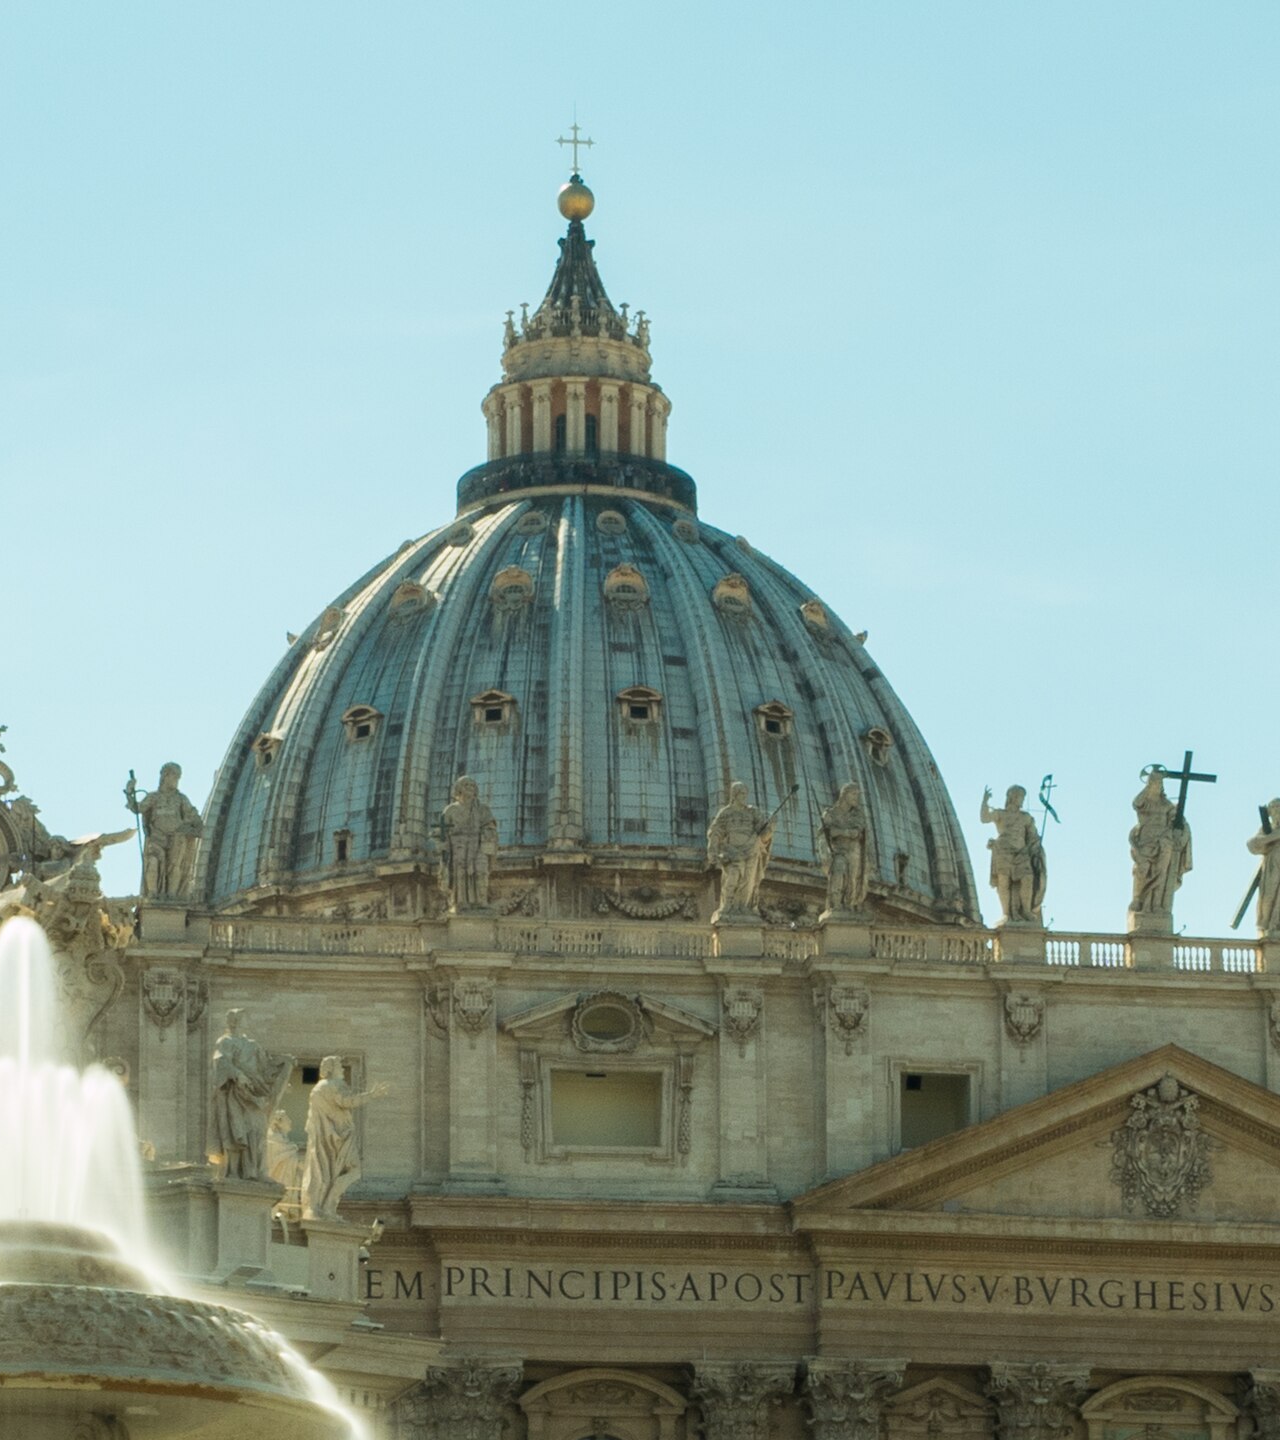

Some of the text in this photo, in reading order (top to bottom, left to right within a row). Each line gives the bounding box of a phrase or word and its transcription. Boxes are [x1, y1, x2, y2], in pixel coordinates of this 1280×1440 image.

[444, 1266, 667, 1300] PRINCIPIS
[679, 1271, 811, 1304] APOST
[825, 1269, 967, 1304] PAVLVS
[975, 1274, 1006, 1304] V
[1011, 1275, 1276, 1313] BVRGHESIVS
